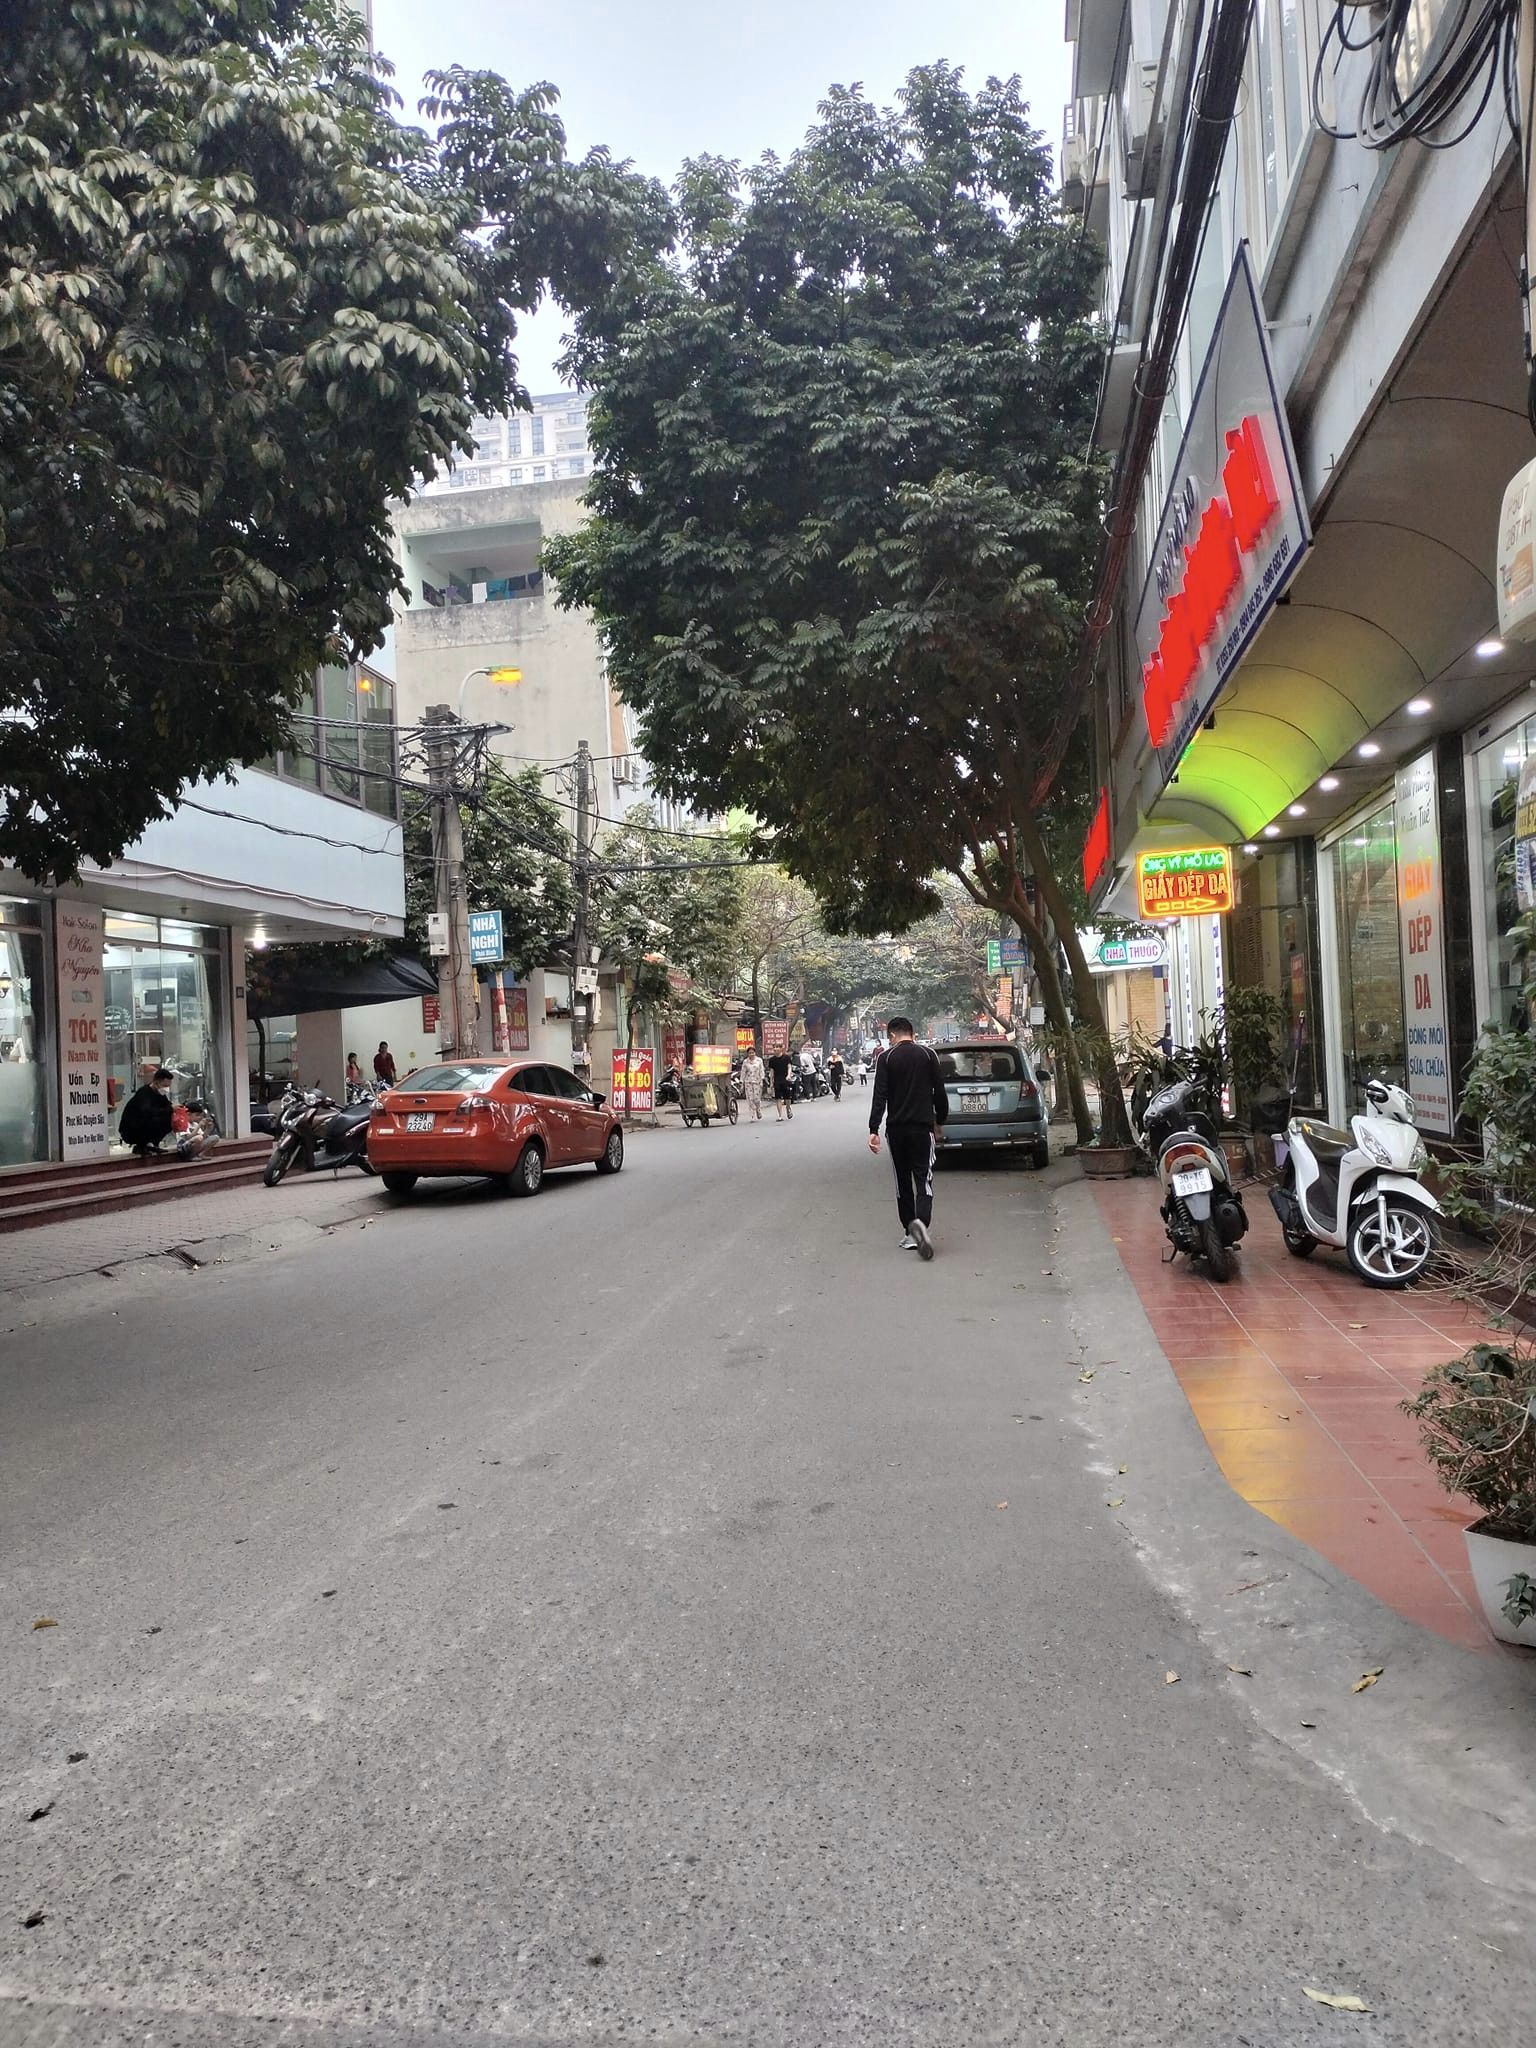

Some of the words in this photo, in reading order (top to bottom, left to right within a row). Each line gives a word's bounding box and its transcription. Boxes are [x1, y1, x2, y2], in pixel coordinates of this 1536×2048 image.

[1178, 870, 1205, 898] DÉP
[1207, 872, 1229, 896] DA
[472, 913, 497, 931] NHÀ
[1408, 909, 1432, 954] DÉP
[471, 930, 499, 950] NGHỈ
[1414, 973, 1432, 1010] DA
[68, 1014, 98, 1043] TÓC
[68, 1050, 86, 1062] Nam
[68, 1070, 84, 1085] Uốn
[637, 1068, 652, 1088] BÒ
[631, 1091, 652, 1109] RANG
